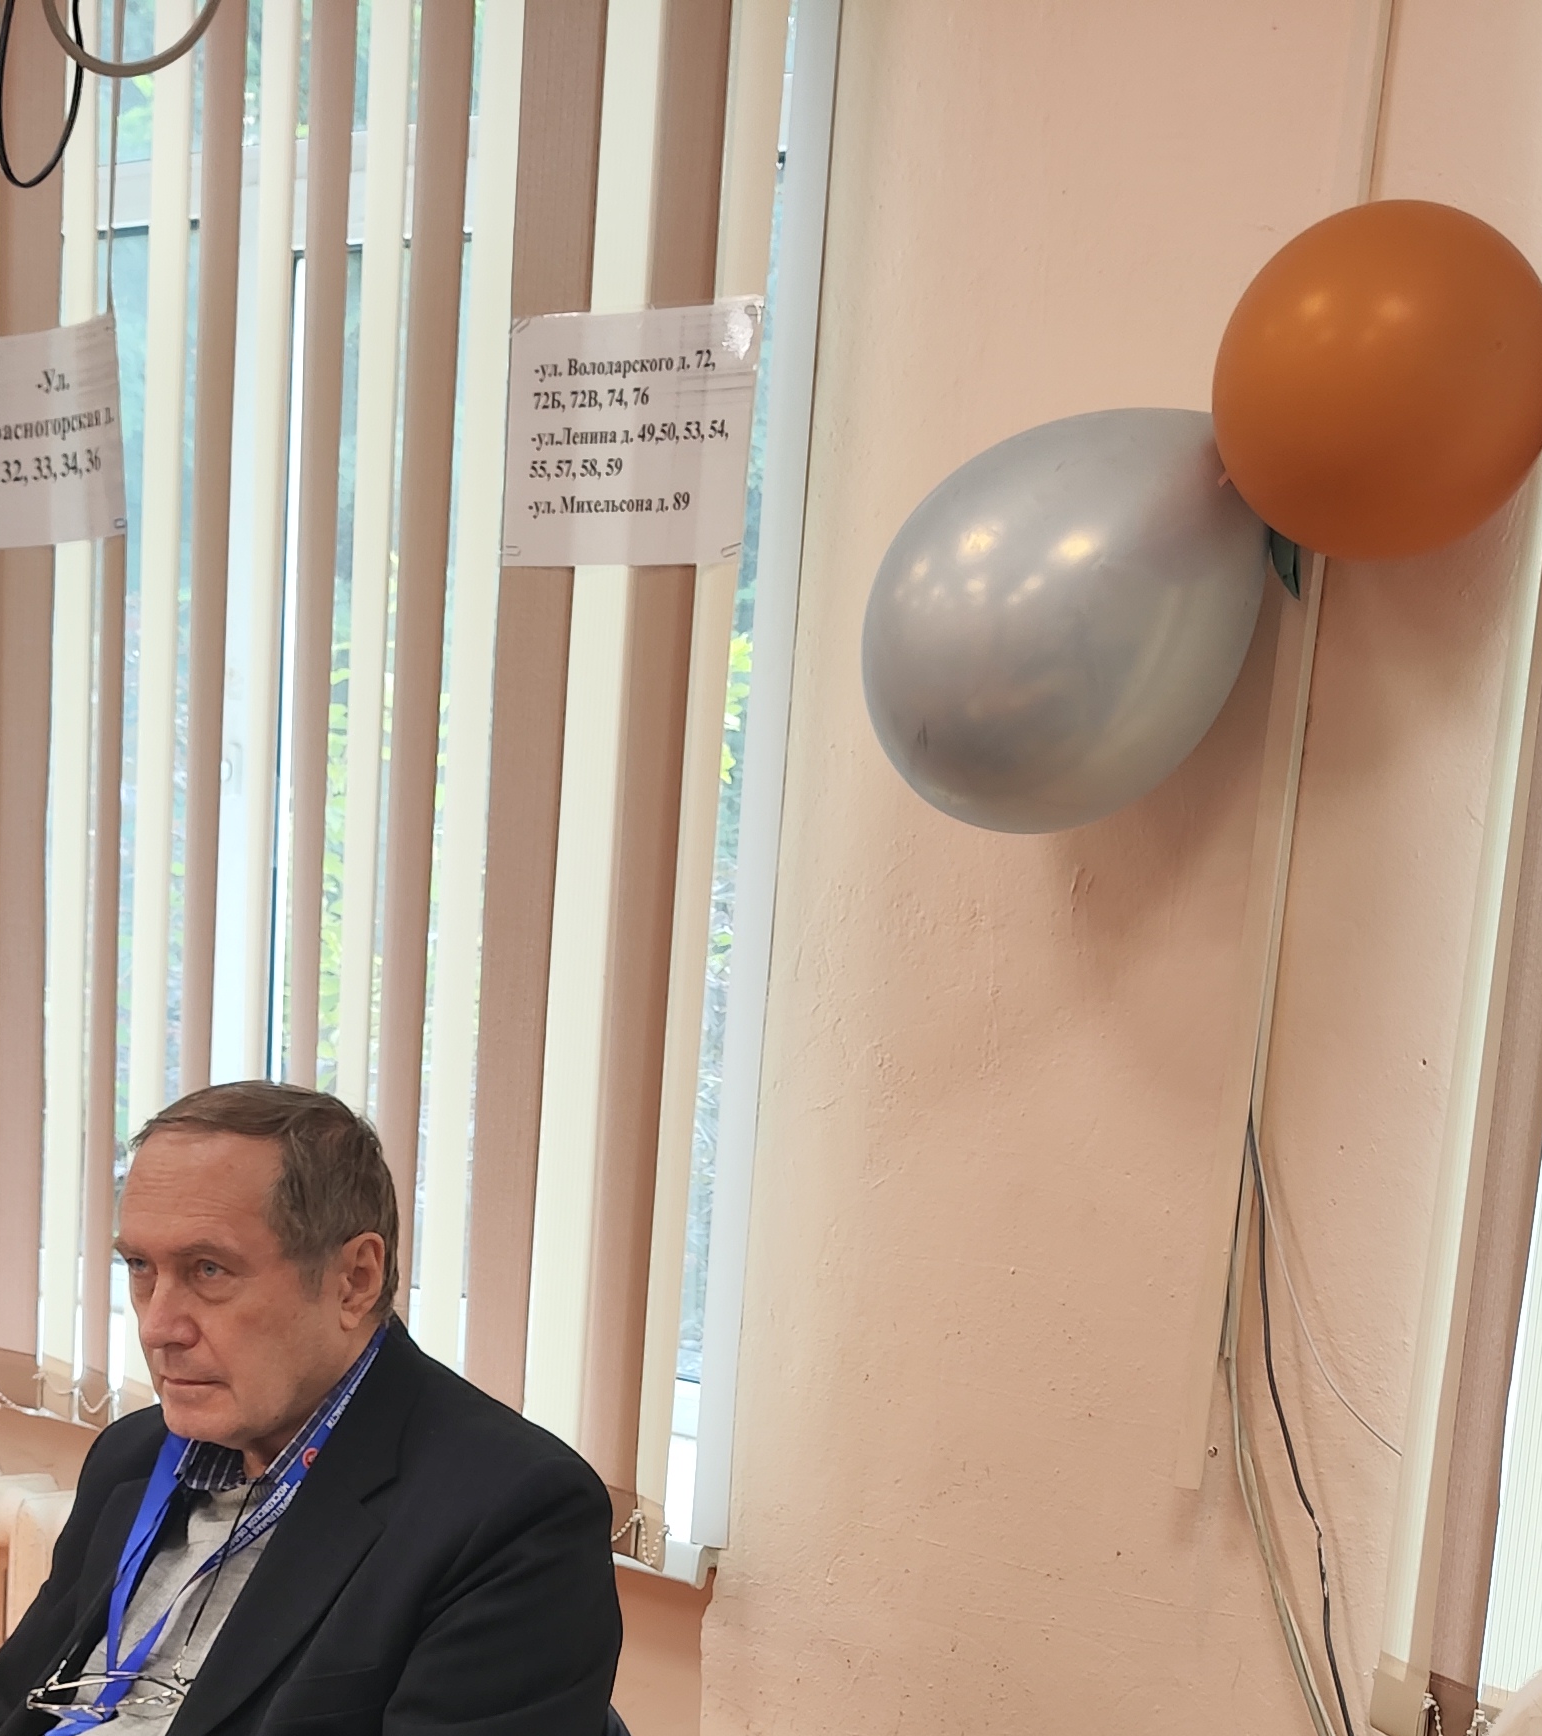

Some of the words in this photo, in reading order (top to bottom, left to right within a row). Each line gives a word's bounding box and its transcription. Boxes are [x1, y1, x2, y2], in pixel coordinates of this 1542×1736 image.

[534, 365, 562, 383] -ул.
[567, 357, 673, 379] Володарского
[677, 355, 690, 372] д.
[695, 349, 716, 371] 72,
[533, 391, 565, 413] 72Б,
[570, 389, 602, 411] 72В,
[607, 388, 628, 409] 74,
[632, 386, 650, 406] 76
[531, 427, 617, 451] -ул.Ленина
[620, 428, 633, 446] д.
[637, 421, 679, 444] 49,50,
[683, 420, 705, 443] 53,
[708, 419, 729, 441] 54,
[1, 459, 28, 486] 32,
[33, 455, 58, 482] 33,
[60, 451, 83, 480] 34,
[86, 448, 102, 474] 36
[529, 460, 551, 482] 55,
[554, 459, 576, 481] 57,
[579, 458, 602, 480] 58,
[605, 457, 623, 477] 59
[528, 502, 556, 519] -ул.
[560, 495, 652, 515] Михельсона
[655, 495, 669, 513] д.
[672, 491, 691, 511] 89
